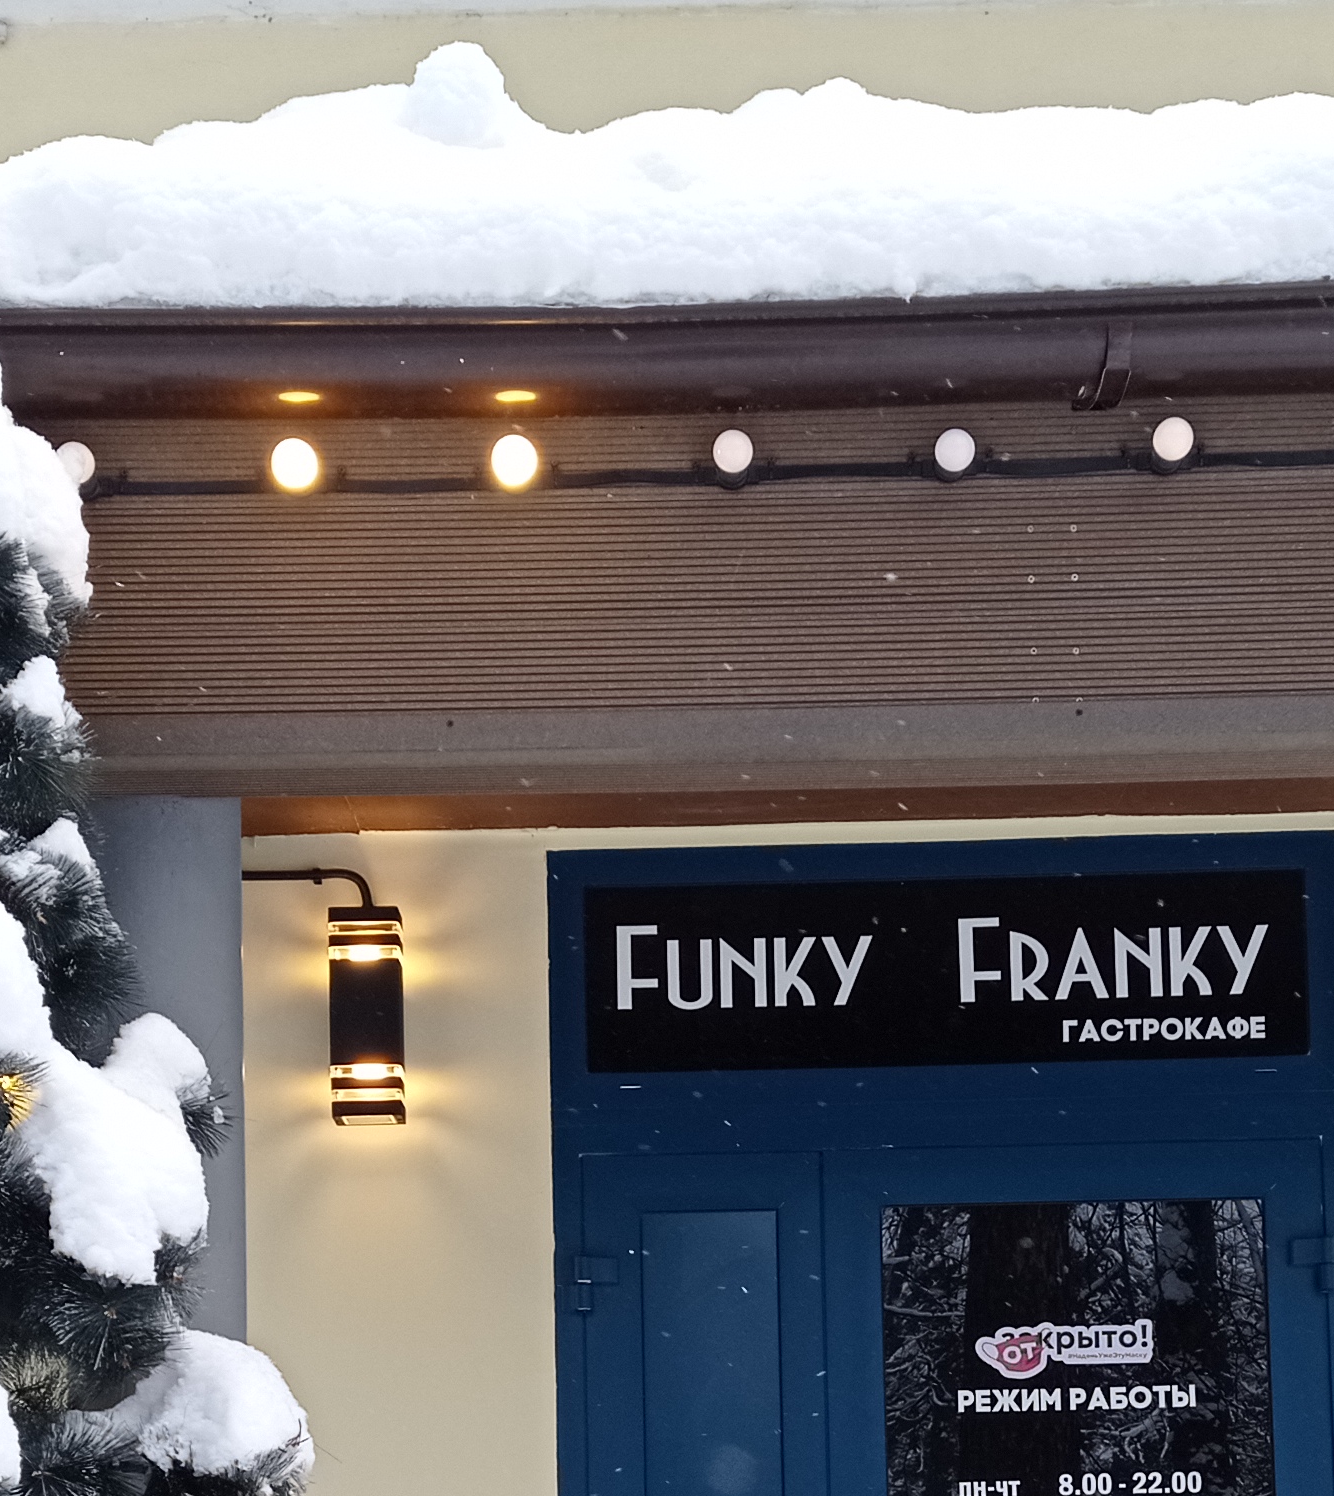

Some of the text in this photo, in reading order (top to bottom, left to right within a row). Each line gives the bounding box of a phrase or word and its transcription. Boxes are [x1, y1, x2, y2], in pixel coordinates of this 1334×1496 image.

[615, 916, 1269, 1011] FUNKY FRANKY
[1062, 1015, 1267, 1044] ГАСТРОКАФЕ
[957, 1384, 1197, 1413] РЕЖИМ РАБОТЫ
[1058, 1473, 1112, 1496] 8.00
[1132, 1471, 1202, 1494] 22.00
